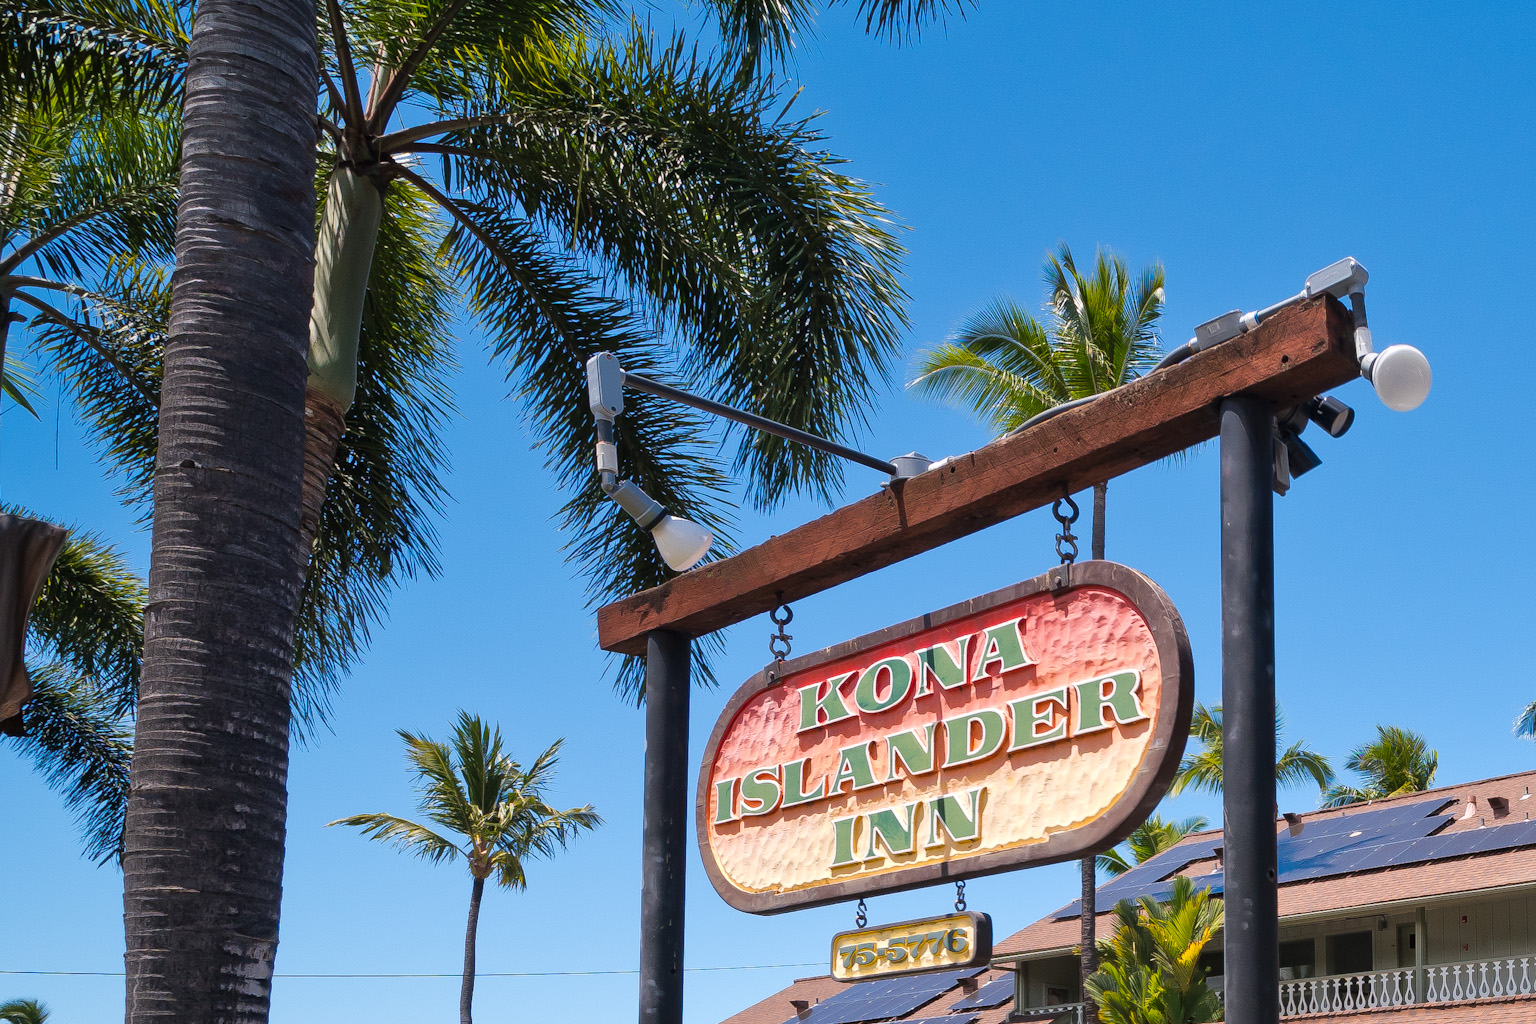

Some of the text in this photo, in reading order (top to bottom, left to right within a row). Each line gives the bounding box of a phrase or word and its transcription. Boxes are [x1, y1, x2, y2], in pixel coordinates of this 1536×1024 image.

[796, 616, 1036, 734] KONA
[714, 669, 1150, 825] ISLANDER
[830, 787, 987, 868] INN
[839, 928, 970, 968] 75-5776
